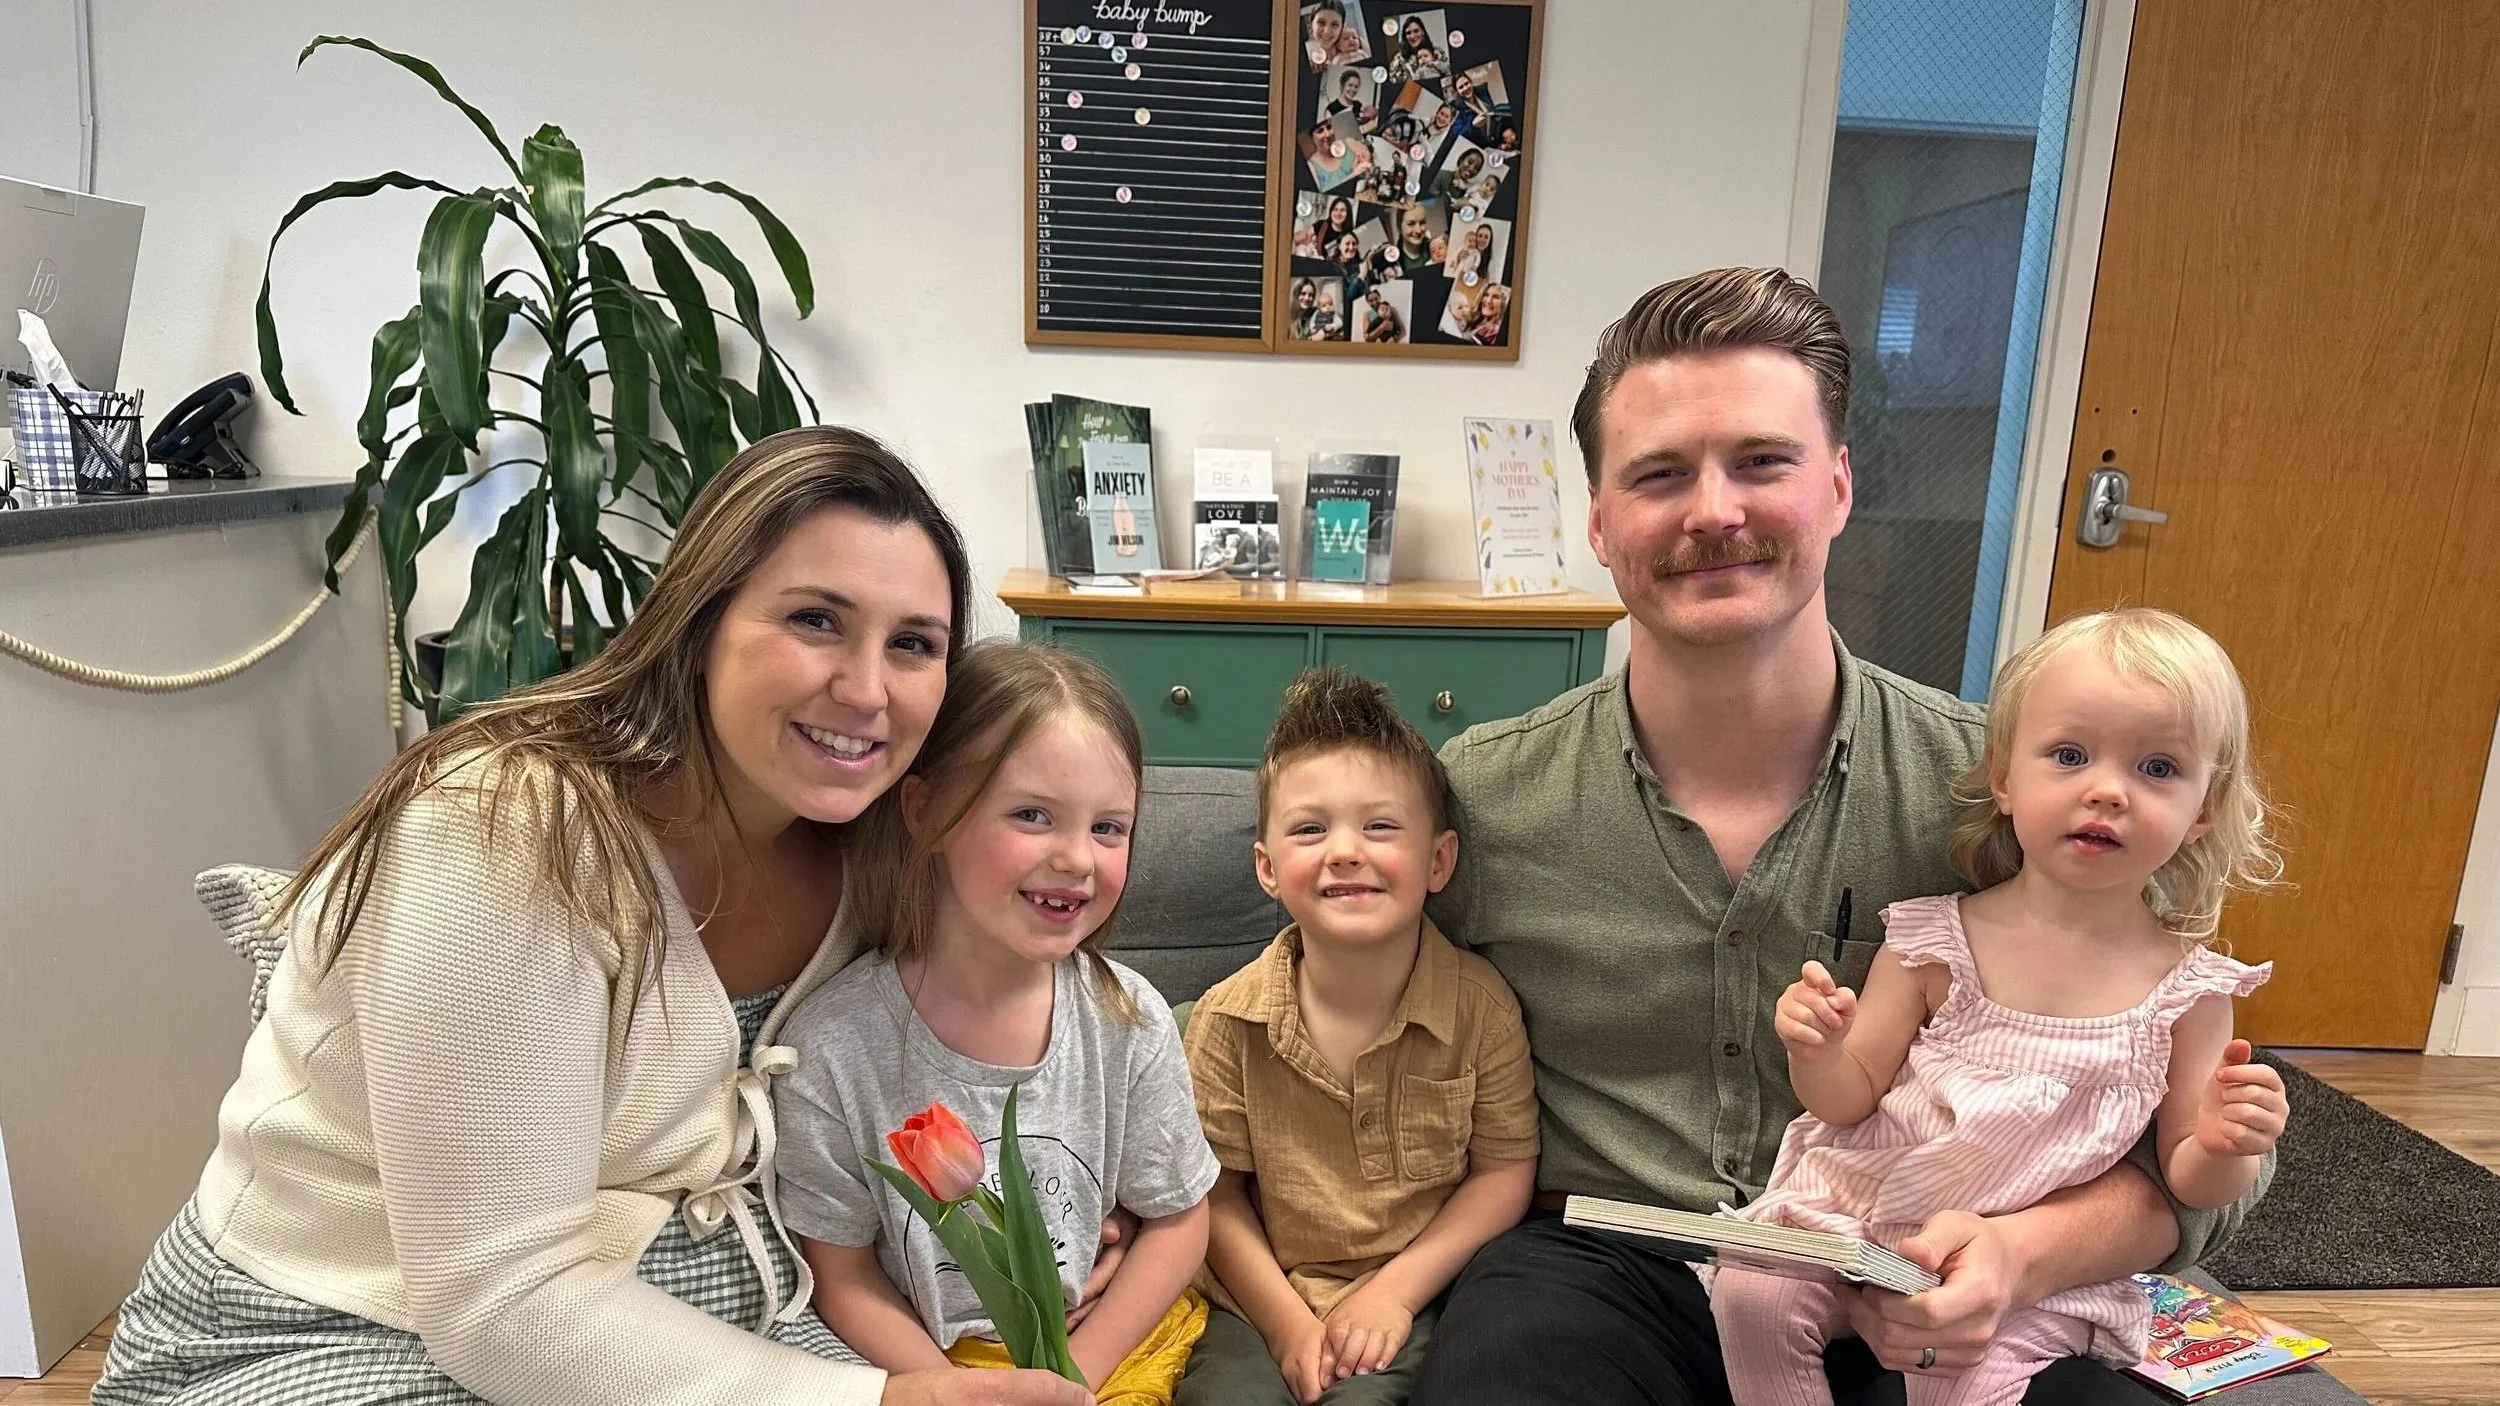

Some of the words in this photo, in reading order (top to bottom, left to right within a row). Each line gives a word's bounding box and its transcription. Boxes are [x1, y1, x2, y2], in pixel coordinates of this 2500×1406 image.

[1092, 0, 1150, 32] baby
[1154, 0, 1212, 35] bump
[1039, 31, 1060, 42] 38+
[1039, 46, 1051, 56] 37
[1039, 61, 1051, 71] 36
[1039, 76, 1051, 87] 35
[1039, 92, 1050, 102] 34
[1039, 106, 1051, 117] 33
[1039, 122, 1051, 133] 32
[1039, 137, 1049, 147] 31
[1039, 153, 1051, 163] 30
[1039, 168, 1051, 178] 29
[1039, 183, 1051, 194] 28
[1039, 199, 1050, 209] 27
[1039, 229, 1051, 238] 25
[1039, 243, 1051, 254] 24
[1039, 258, 1052, 268] 23
[1039, 273, 1051, 282] 22
[28, 258, 60, 313] hp
[1039, 288, 1050, 298] 21
[1039, 303, 1050, 314] 20
[1500, 461, 1529, 473] HAPPY
[1094, 471, 1145, 496] ANXIETY
[1492, 474, 1541, 487] MOTHER'S
[1310, 487, 1358, 496] MAINTAIN
[1362, 489, 1382, 497] JOY
[1507, 488, 1526, 500] DAY
[1207, 509, 1243, 519] LOVE
[2178, 1340, 2242, 1362] Cars
